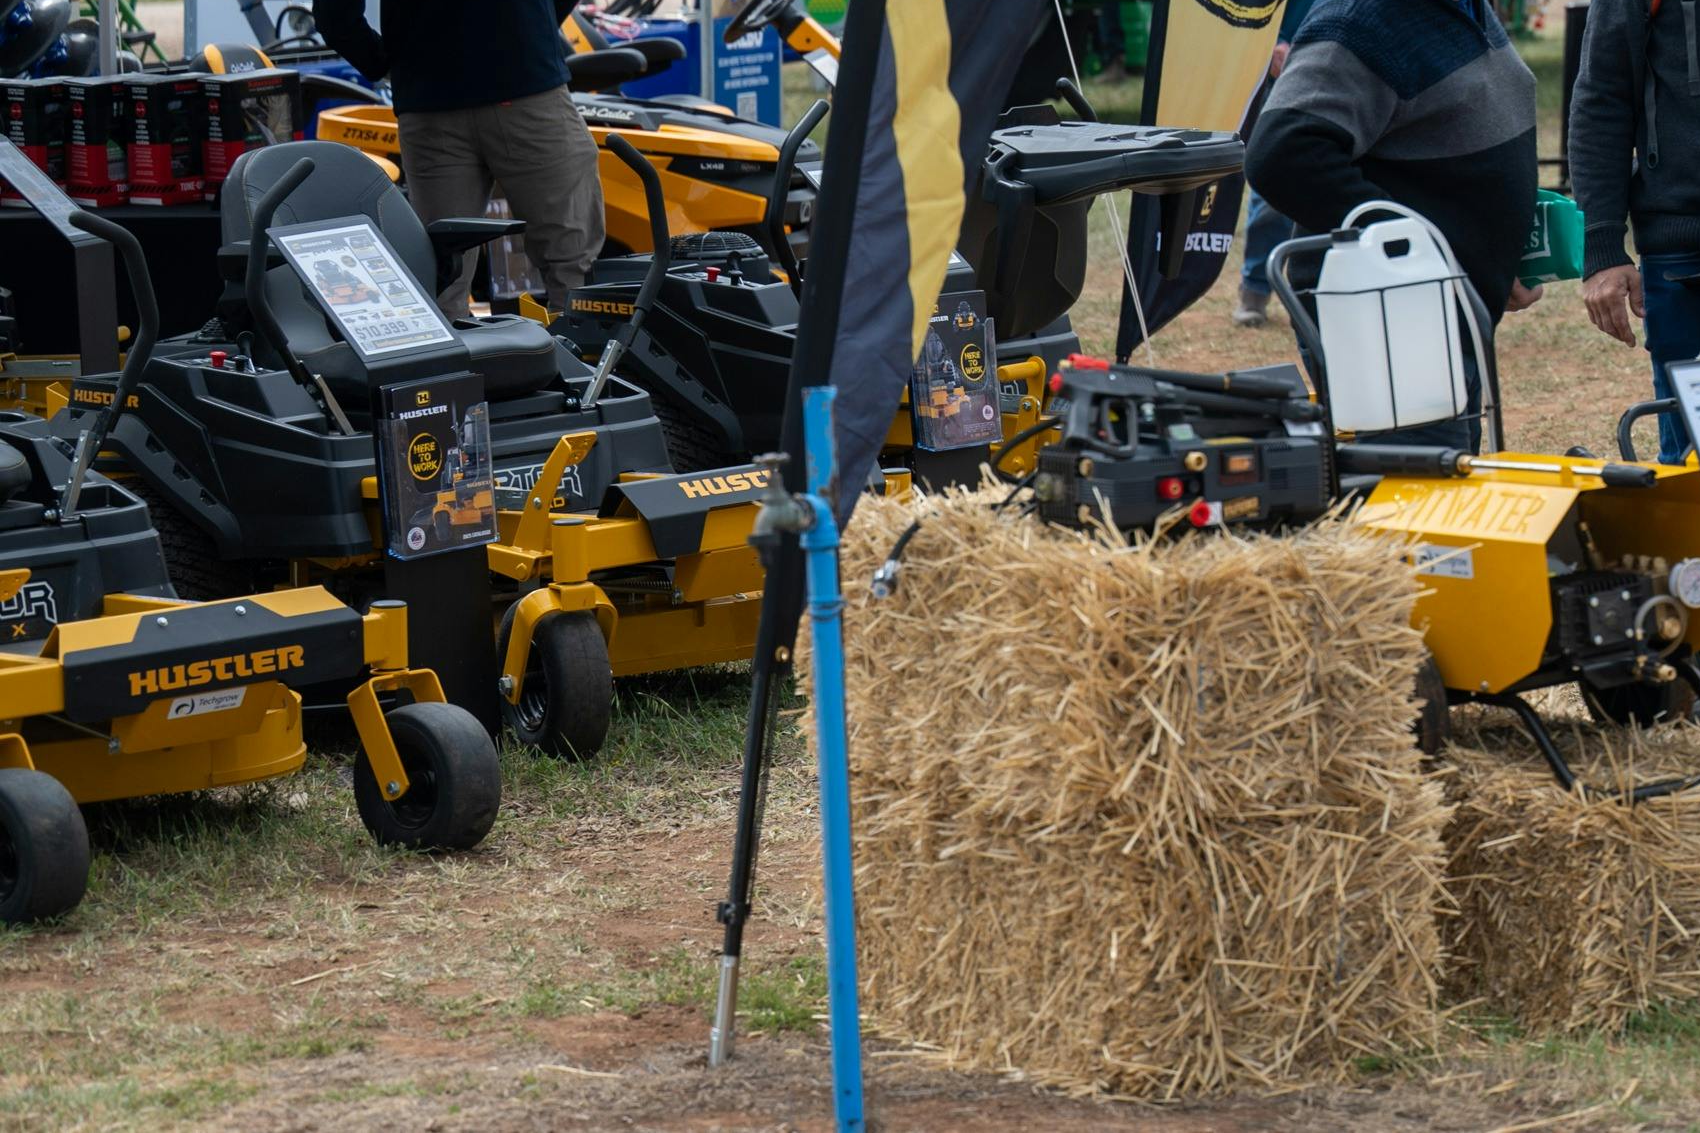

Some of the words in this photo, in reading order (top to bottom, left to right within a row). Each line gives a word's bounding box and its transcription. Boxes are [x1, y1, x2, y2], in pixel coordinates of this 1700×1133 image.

[74, 389, 139, 408] HUSTR
[399, 404, 448, 420] HUSTLER
[413, 441, 436, 456] HERE
[418, 454, 432, 462] TO
[412, 460, 438, 473] WORK
[678, 469, 771, 499] HUST
[128, 644, 305, 697] HUSTLER
